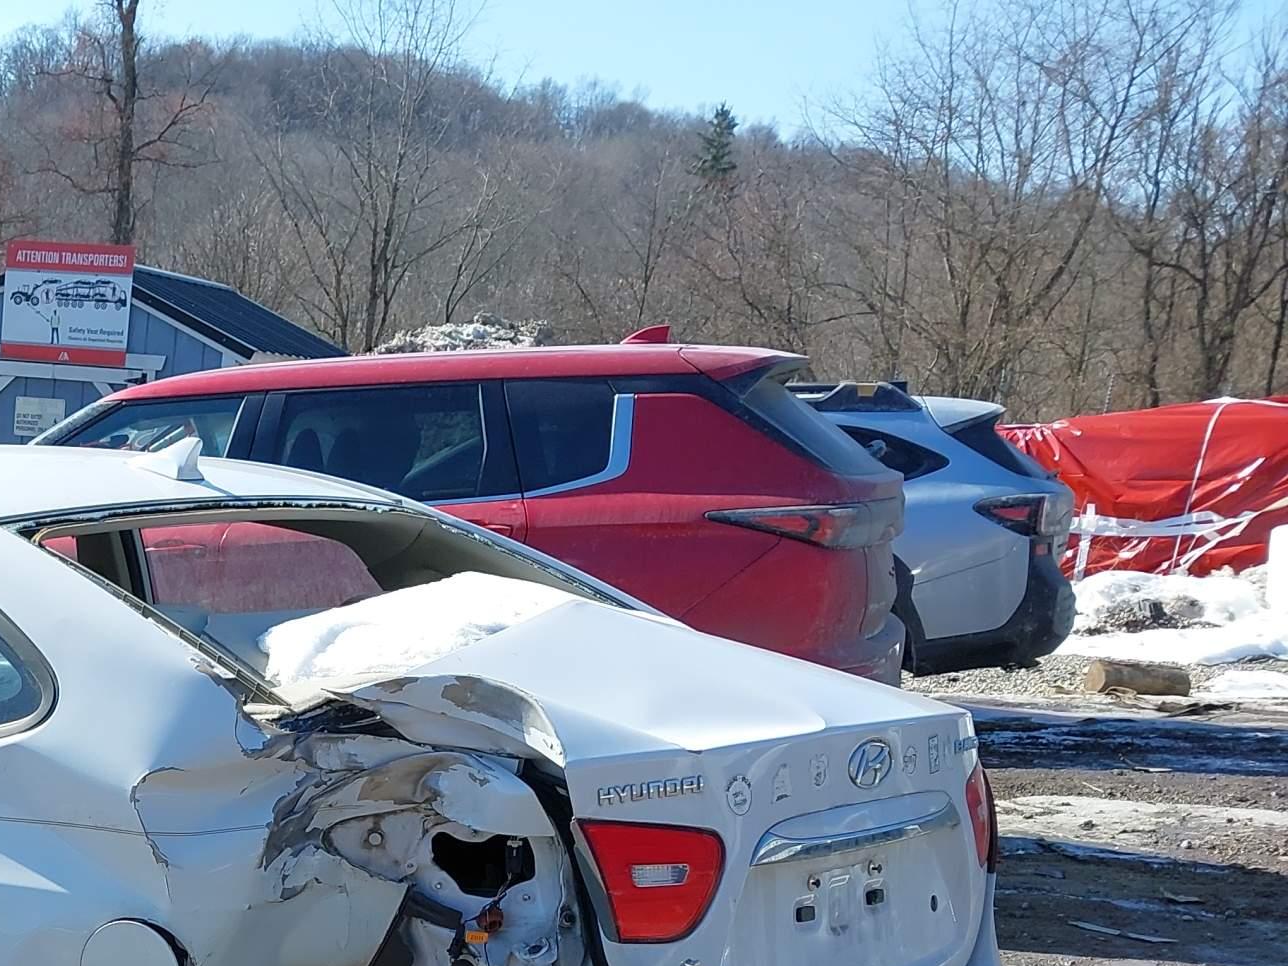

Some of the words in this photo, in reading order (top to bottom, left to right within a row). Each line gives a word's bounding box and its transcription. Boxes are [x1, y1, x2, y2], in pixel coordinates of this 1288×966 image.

[16, 249, 60, 264] ATTENTION
[62, 252, 128, 267] TRANSPORTERS!
[597, 775, 704, 806] HYUNDAI
